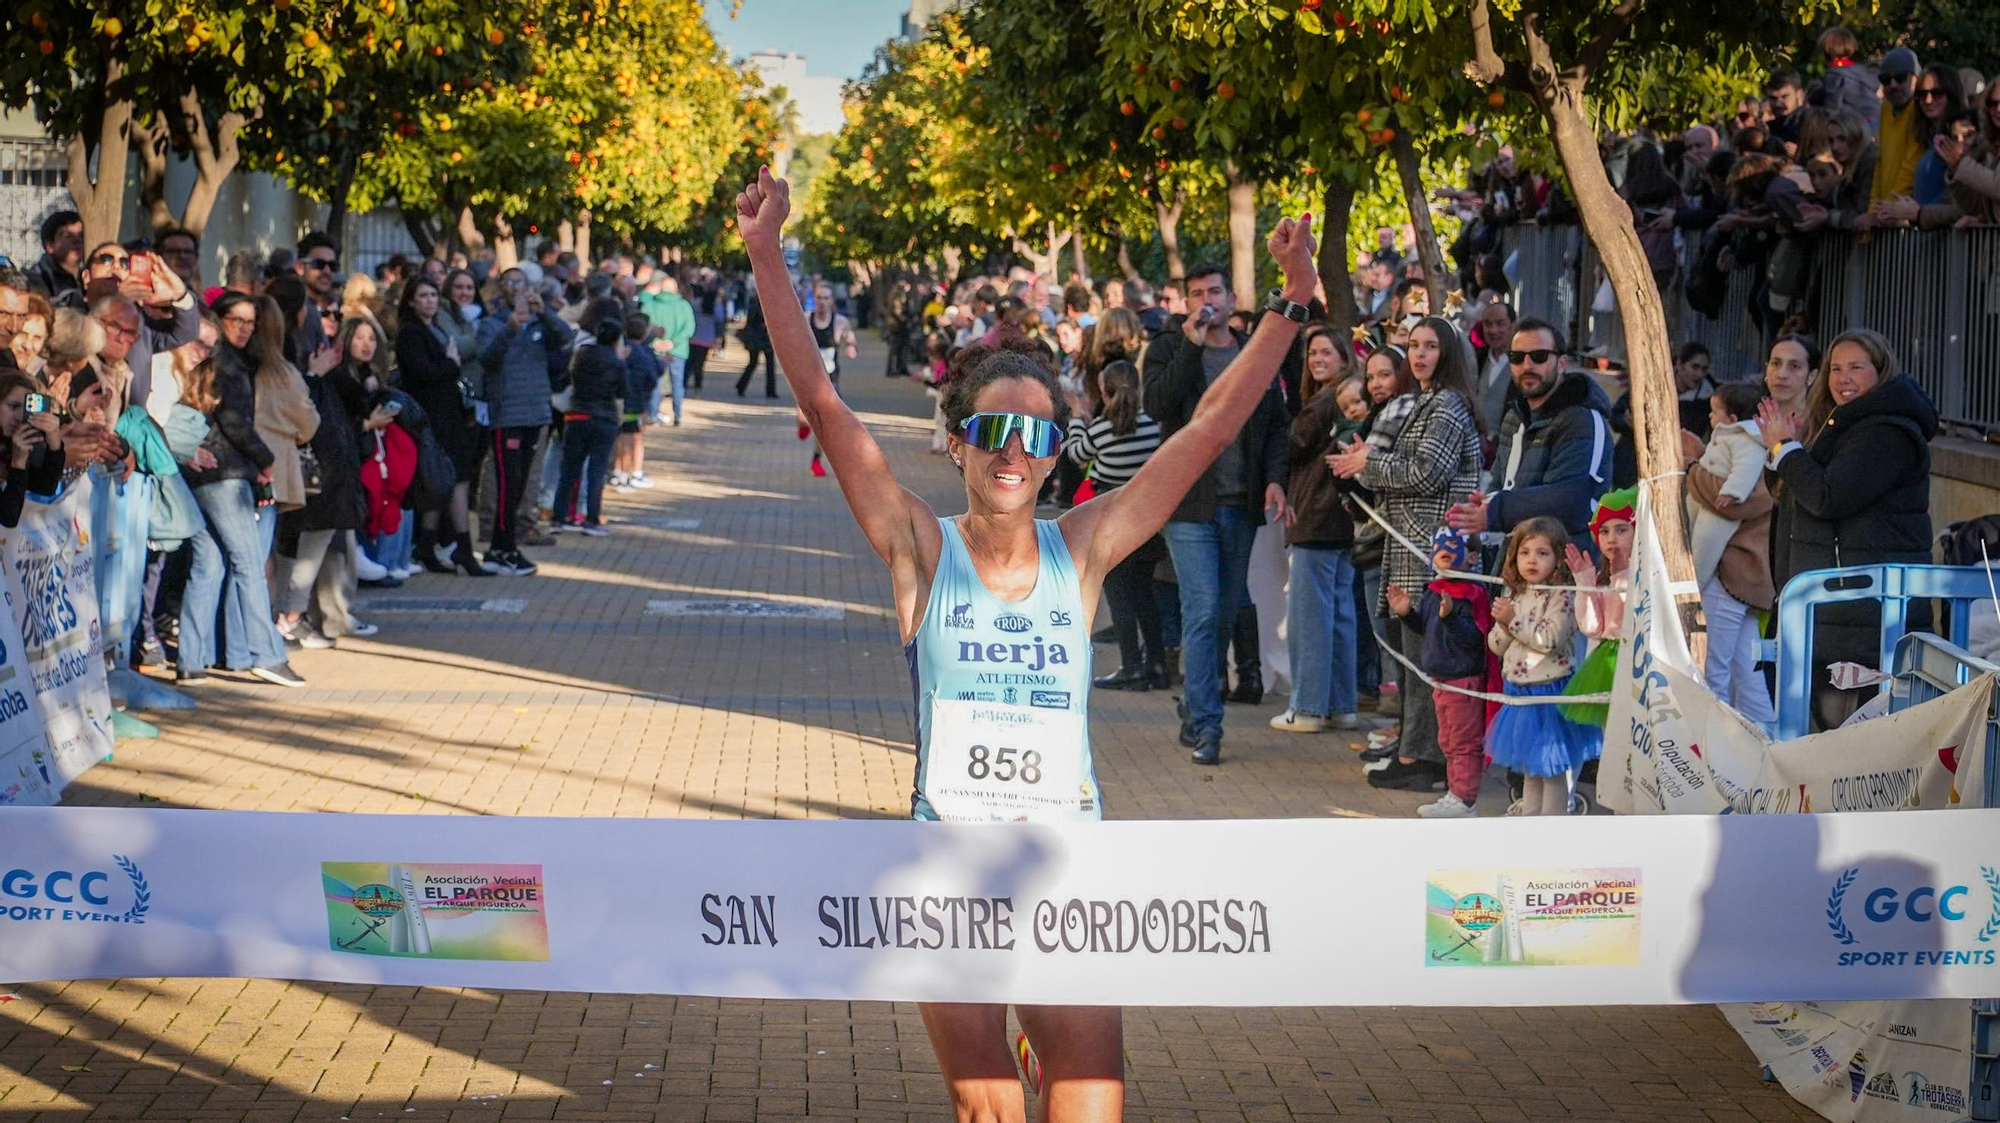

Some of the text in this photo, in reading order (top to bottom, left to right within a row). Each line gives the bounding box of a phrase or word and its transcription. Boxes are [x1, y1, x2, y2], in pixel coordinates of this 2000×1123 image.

[945, 615, 975, 625] CUEVA
[996, 616, 1031, 631] TROPS
[957, 636, 1069, 671] nerja
[976, 673, 1056, 685] ATLETISMO
[968, 744, 1042, 784] 858
[1658, 739, 1705, 791] Diputación
[1831, 775, 1868, 812] CIRCUITO
[2, 869, 109, 905] GCC
[425, 875, 536, 885] Asociación Vecinal
[1527, 879, 1636, 890] Asociación Vecinal
[425, 887, 537, 901] EL PARQUE
[1526, 892, 1635, 906] EL PARQUE
[1864, 885, 1969, 923] GCC
[0, 906, 145, 924] PORT EVENTS
[700, 894, 1272, 954] SAN SILVESTRE CORDOBESA
[1837, 950, 1996, 966] SPORT EVENTS
